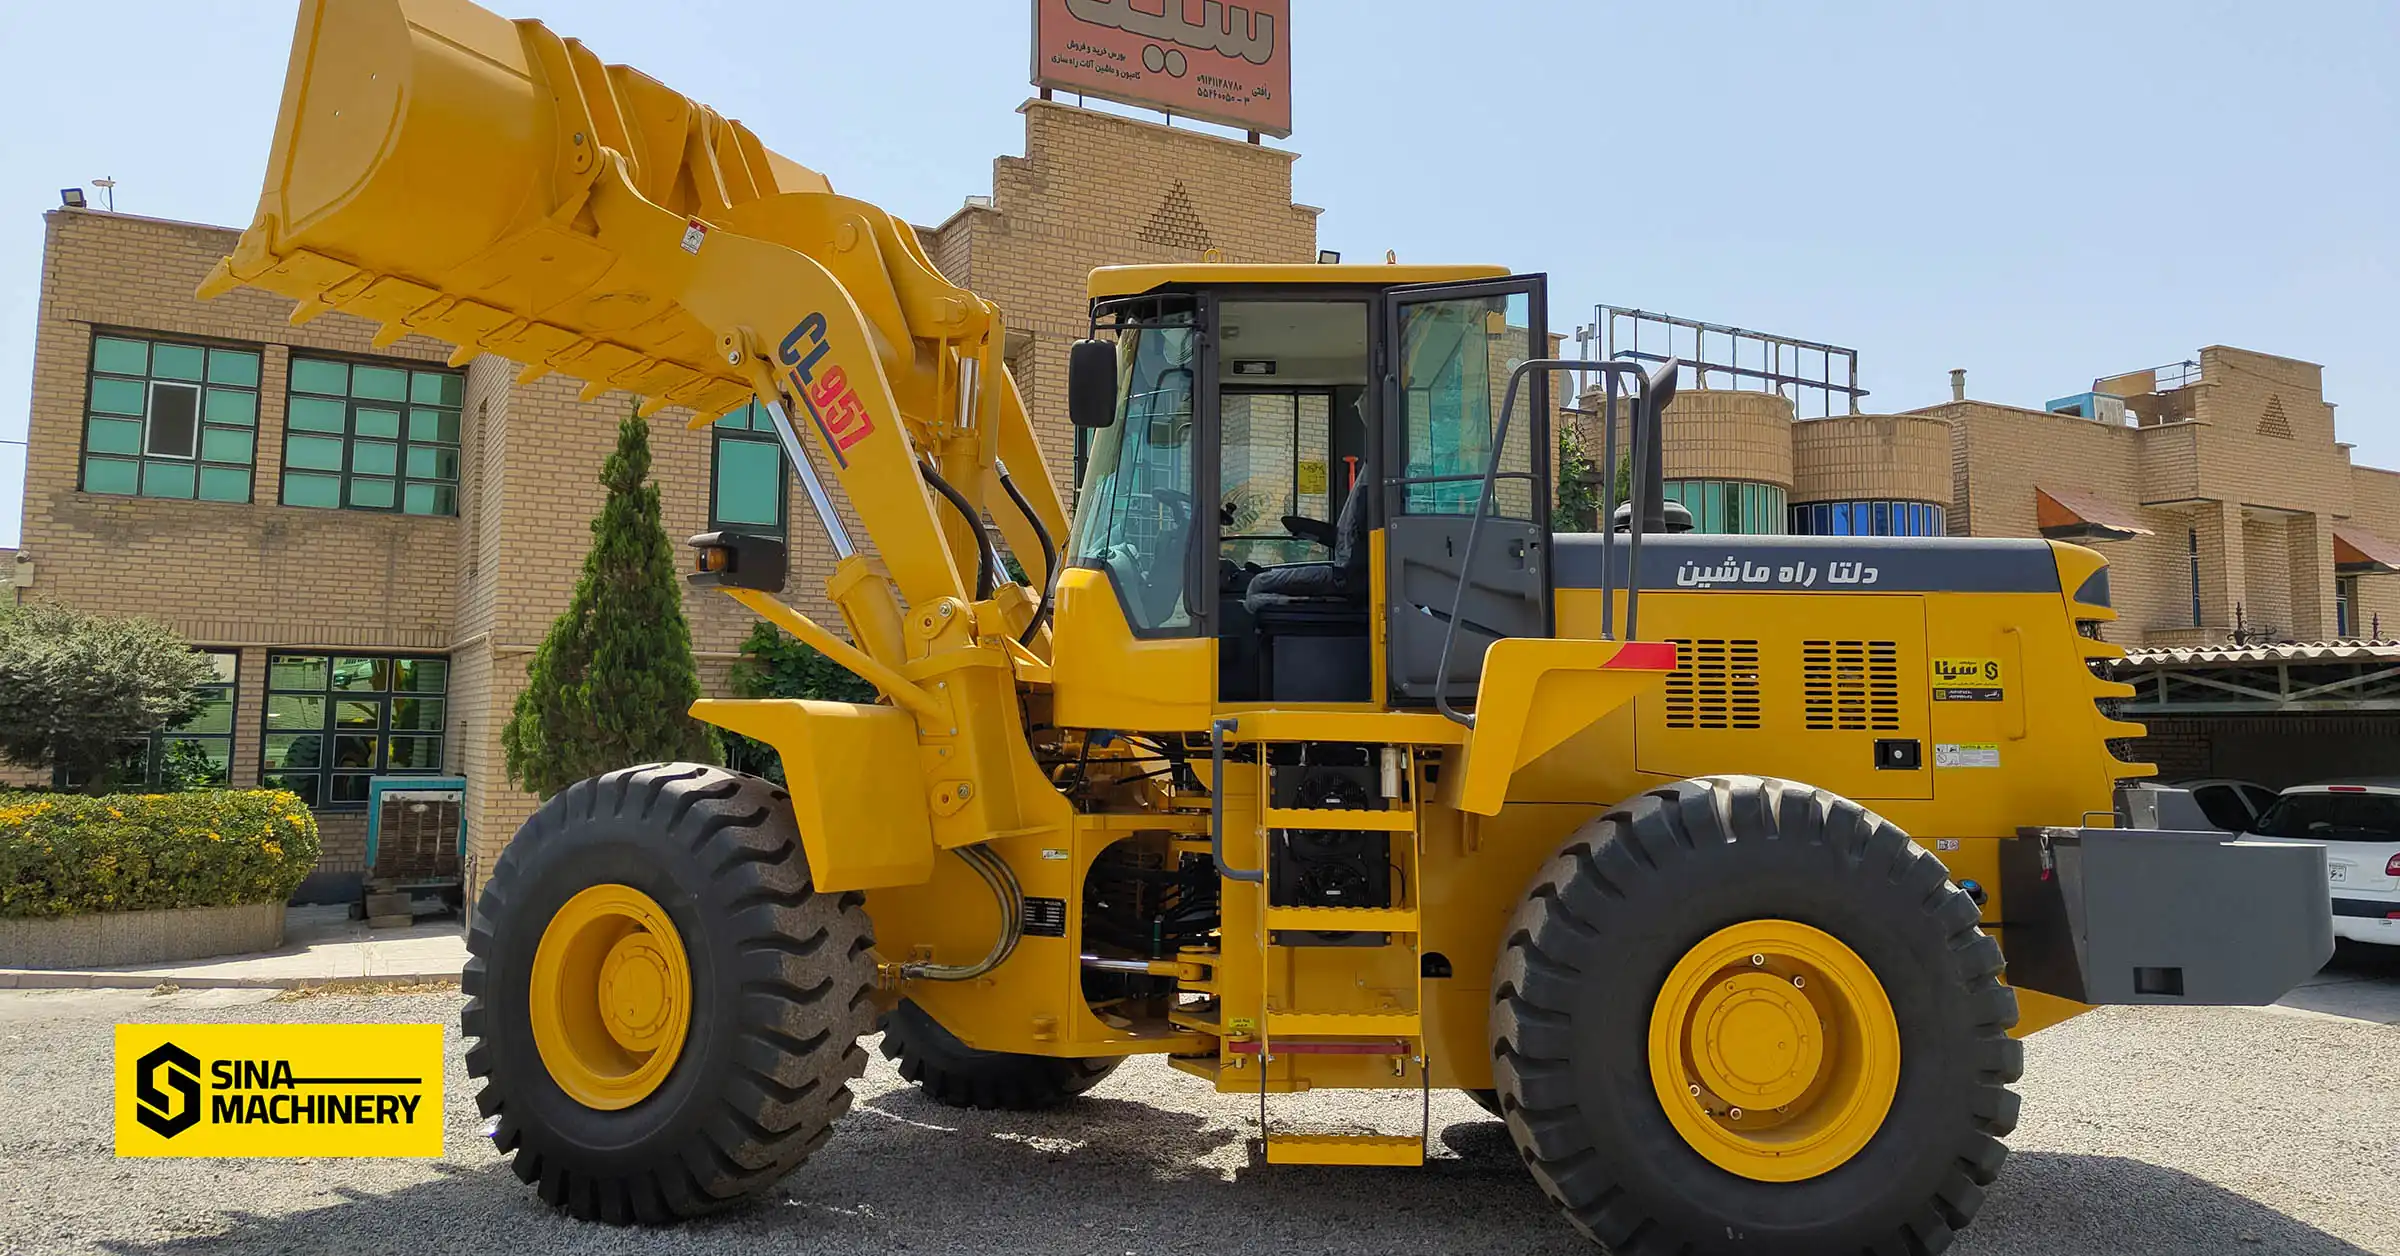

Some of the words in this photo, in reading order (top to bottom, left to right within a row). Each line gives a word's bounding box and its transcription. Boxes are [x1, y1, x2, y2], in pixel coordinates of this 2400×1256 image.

[1066, 40, 1086, 52] فروش
[1092, 47, 1107, 56] خرید
[1095, 64, 1115, 74] ماشین
[777, 311, 876, 451] CL957
[1676, 555, 1771, 588] ماشین
[1778, 561, 1818, 588] راه
[1827, 561, 1879, 584] دلتا
[1934, 660, 1977, 680] سینا
